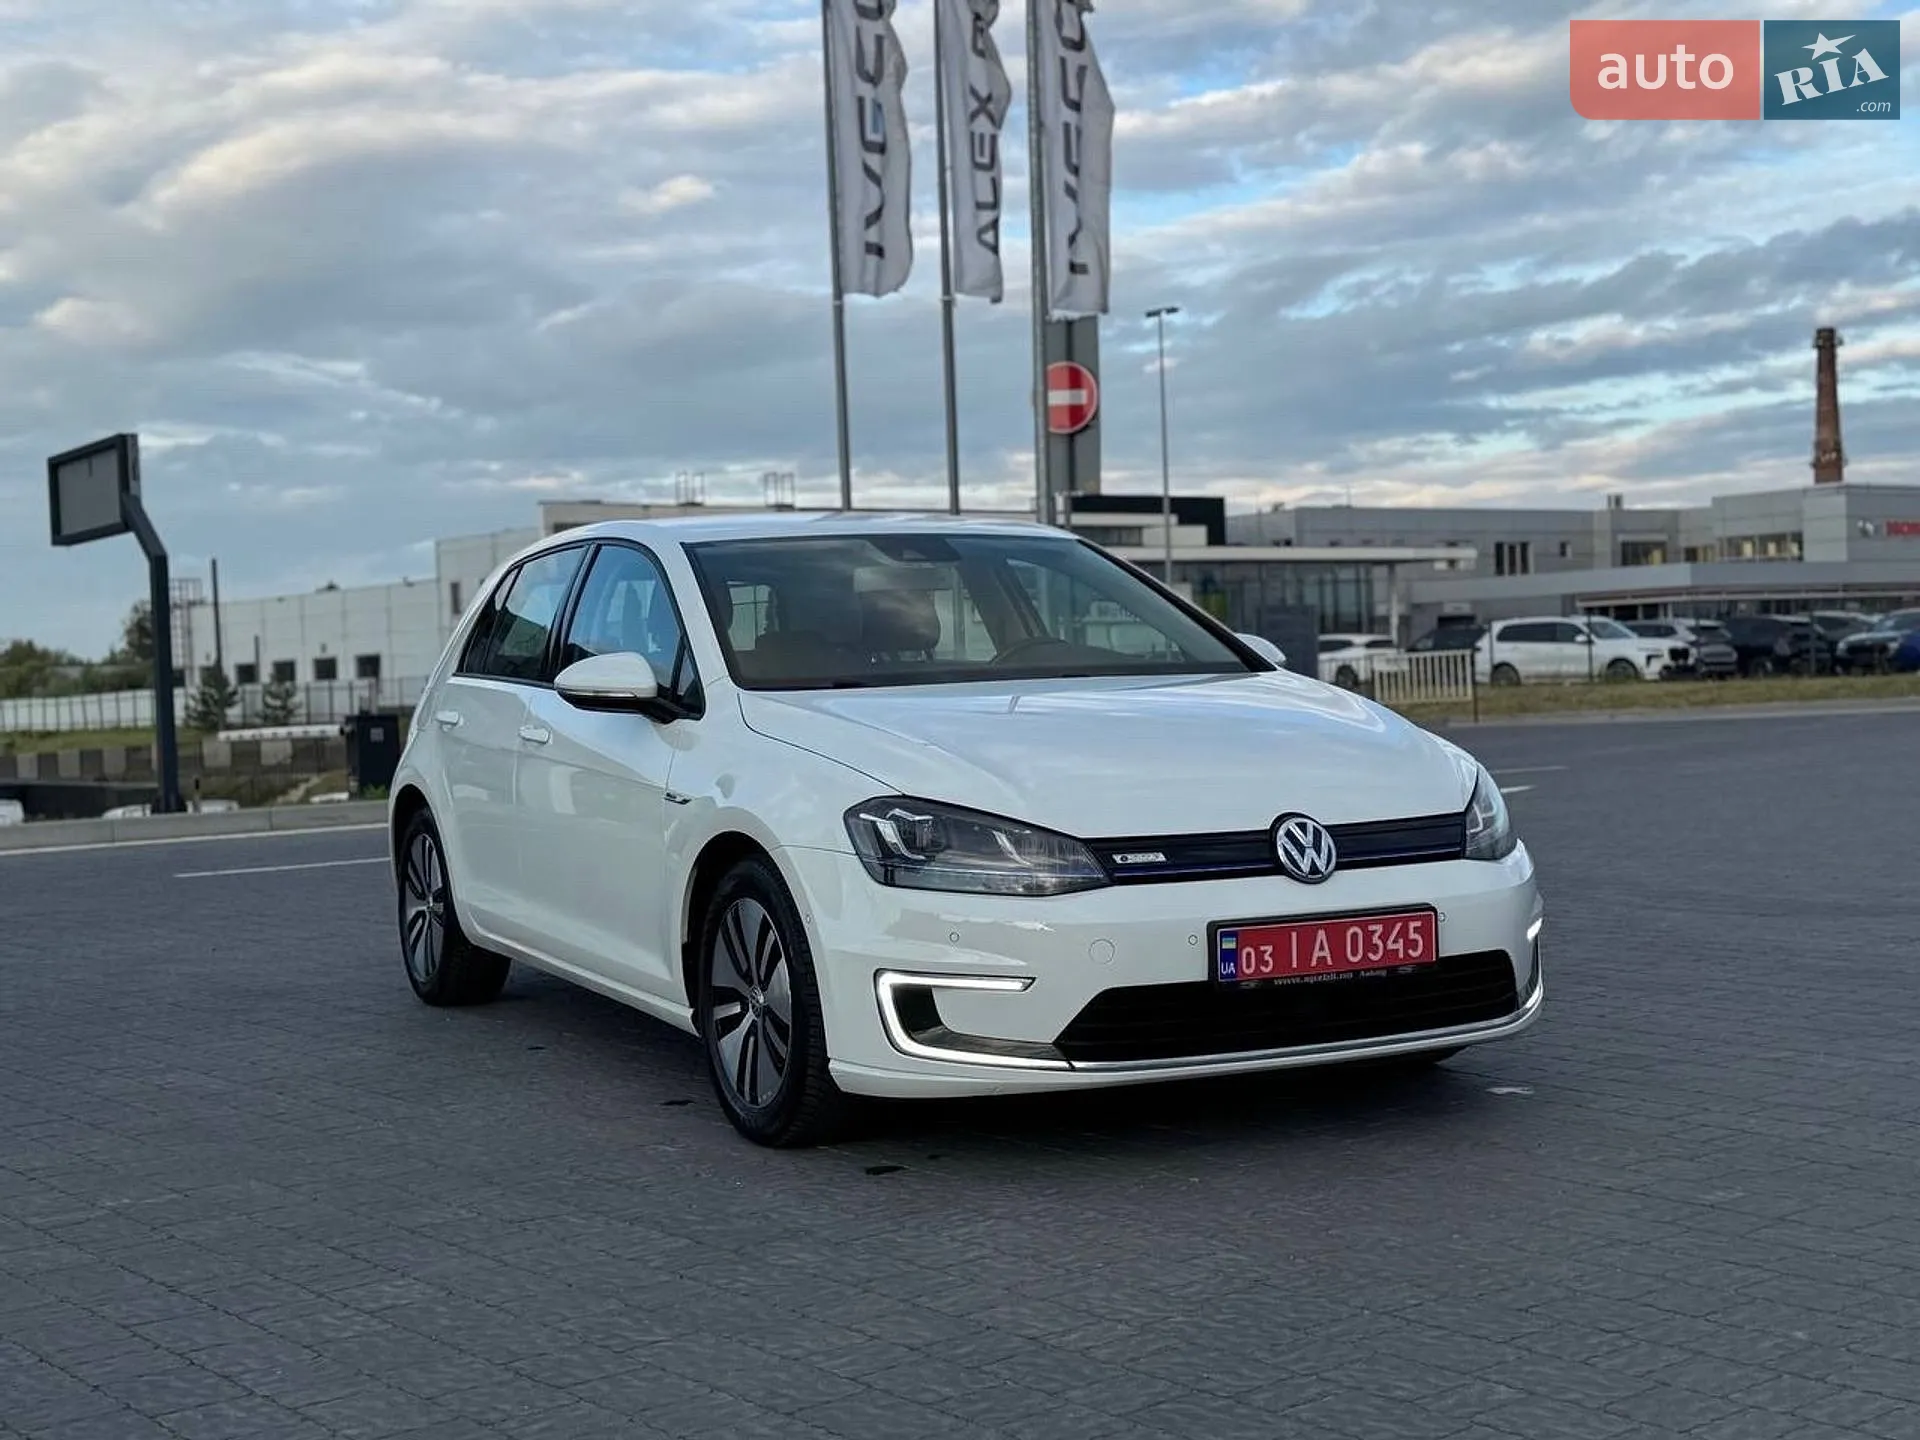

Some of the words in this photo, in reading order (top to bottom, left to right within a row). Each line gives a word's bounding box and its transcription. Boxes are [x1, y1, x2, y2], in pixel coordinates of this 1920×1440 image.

[968, 84, 1001, 256] ALEX
[1221, 961, 1236, 976] UA
[1241, 945, 1274, 975] 03
[1345, 921, 1424, 963] 0345
